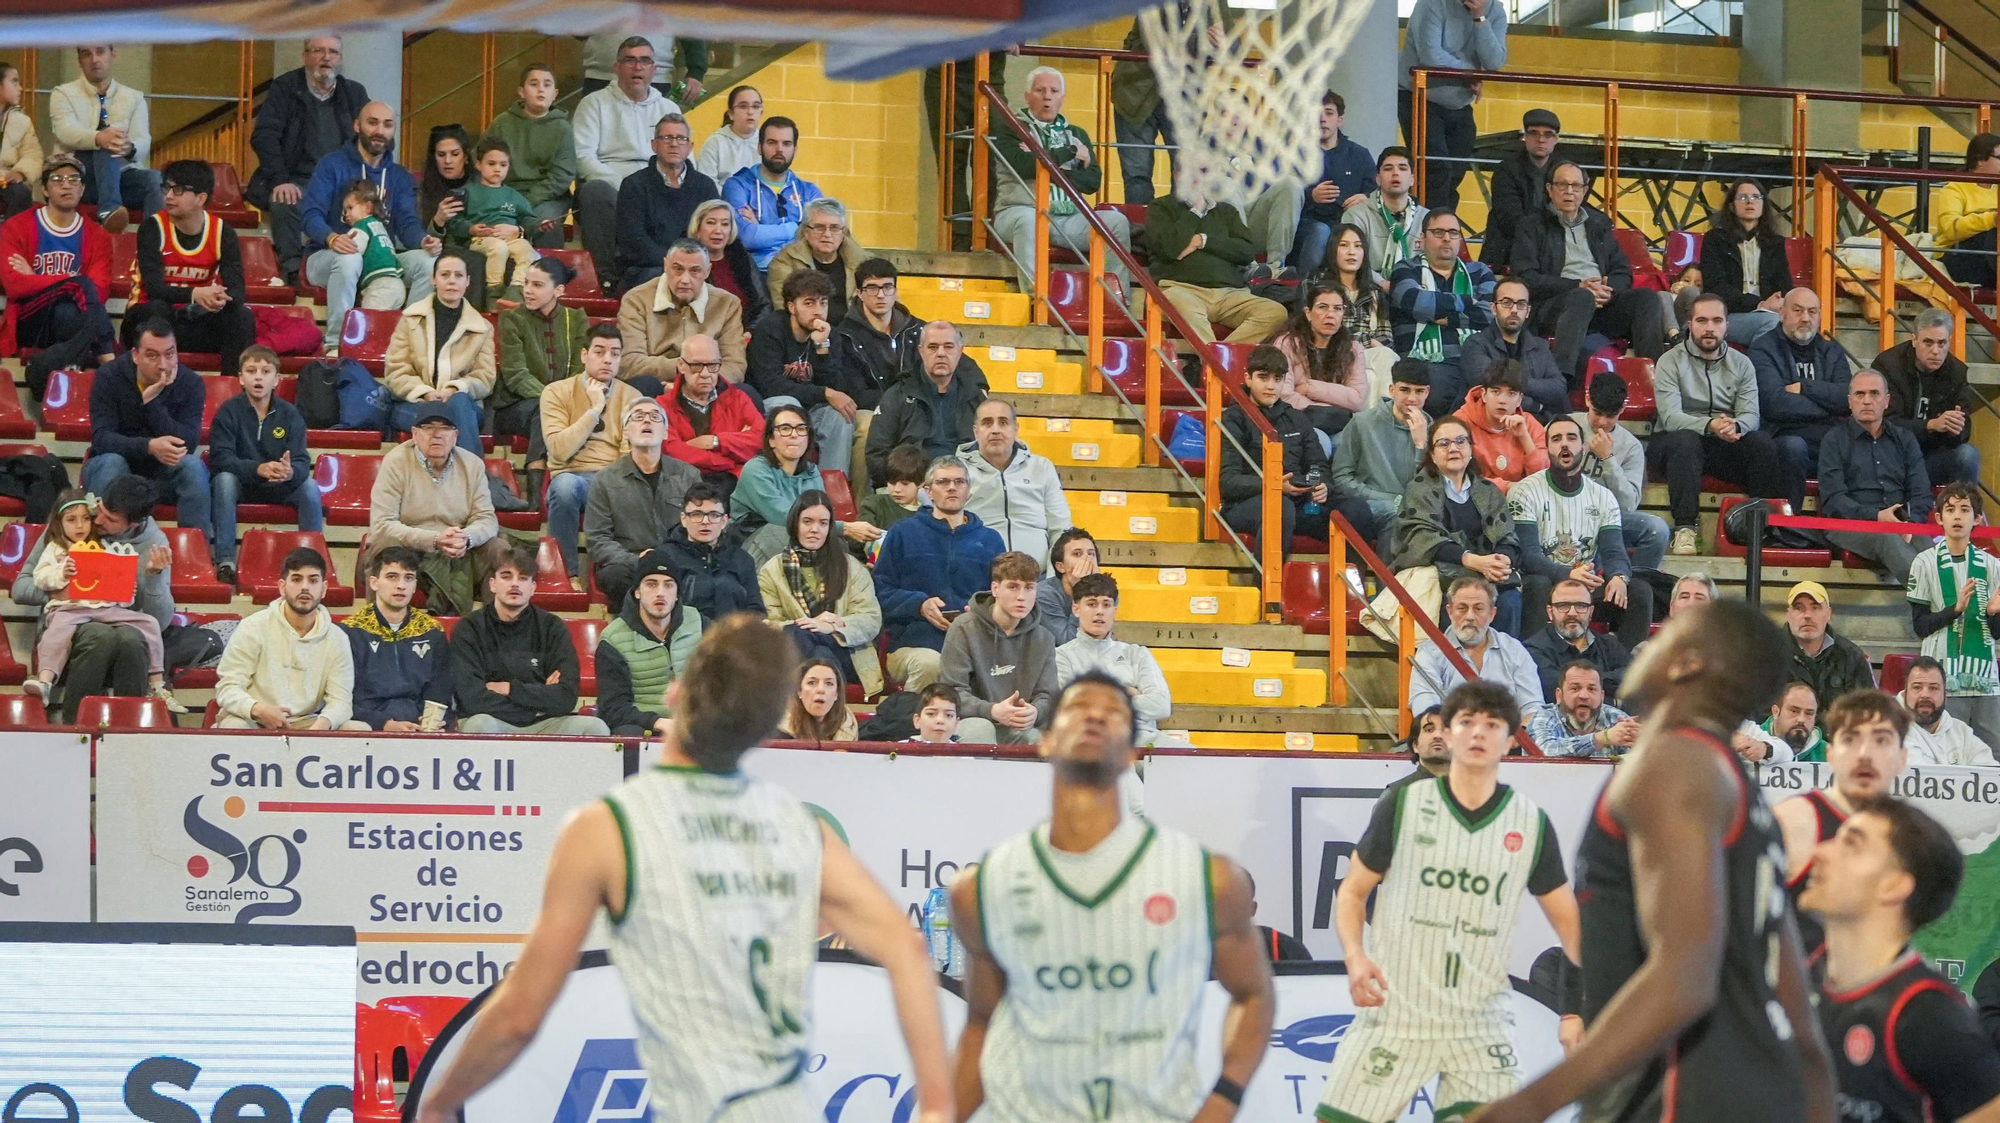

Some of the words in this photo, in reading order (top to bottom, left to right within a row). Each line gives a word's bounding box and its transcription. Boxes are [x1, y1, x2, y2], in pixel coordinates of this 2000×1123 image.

[1155, 629, 1195, 640] FILA
[1218, 714, 1258, 724] FILA
[210, 753, 283, 788] San
[296, 755, 420, 790] Carlos
[453, 758, 482, 792] &
[348, 822, 523, 851] Estaciones
[416, 858, 458, 886] de
[1420, 866, 1490, 895] coto
[185, 886, 269, 901] Sanalemo
[186, 902, 231, 912] Gestión
[370, 894, 503, 923] Servicio
[356, 950, 516, 984] edroch
[1036, 958, 1133, 991] coto
